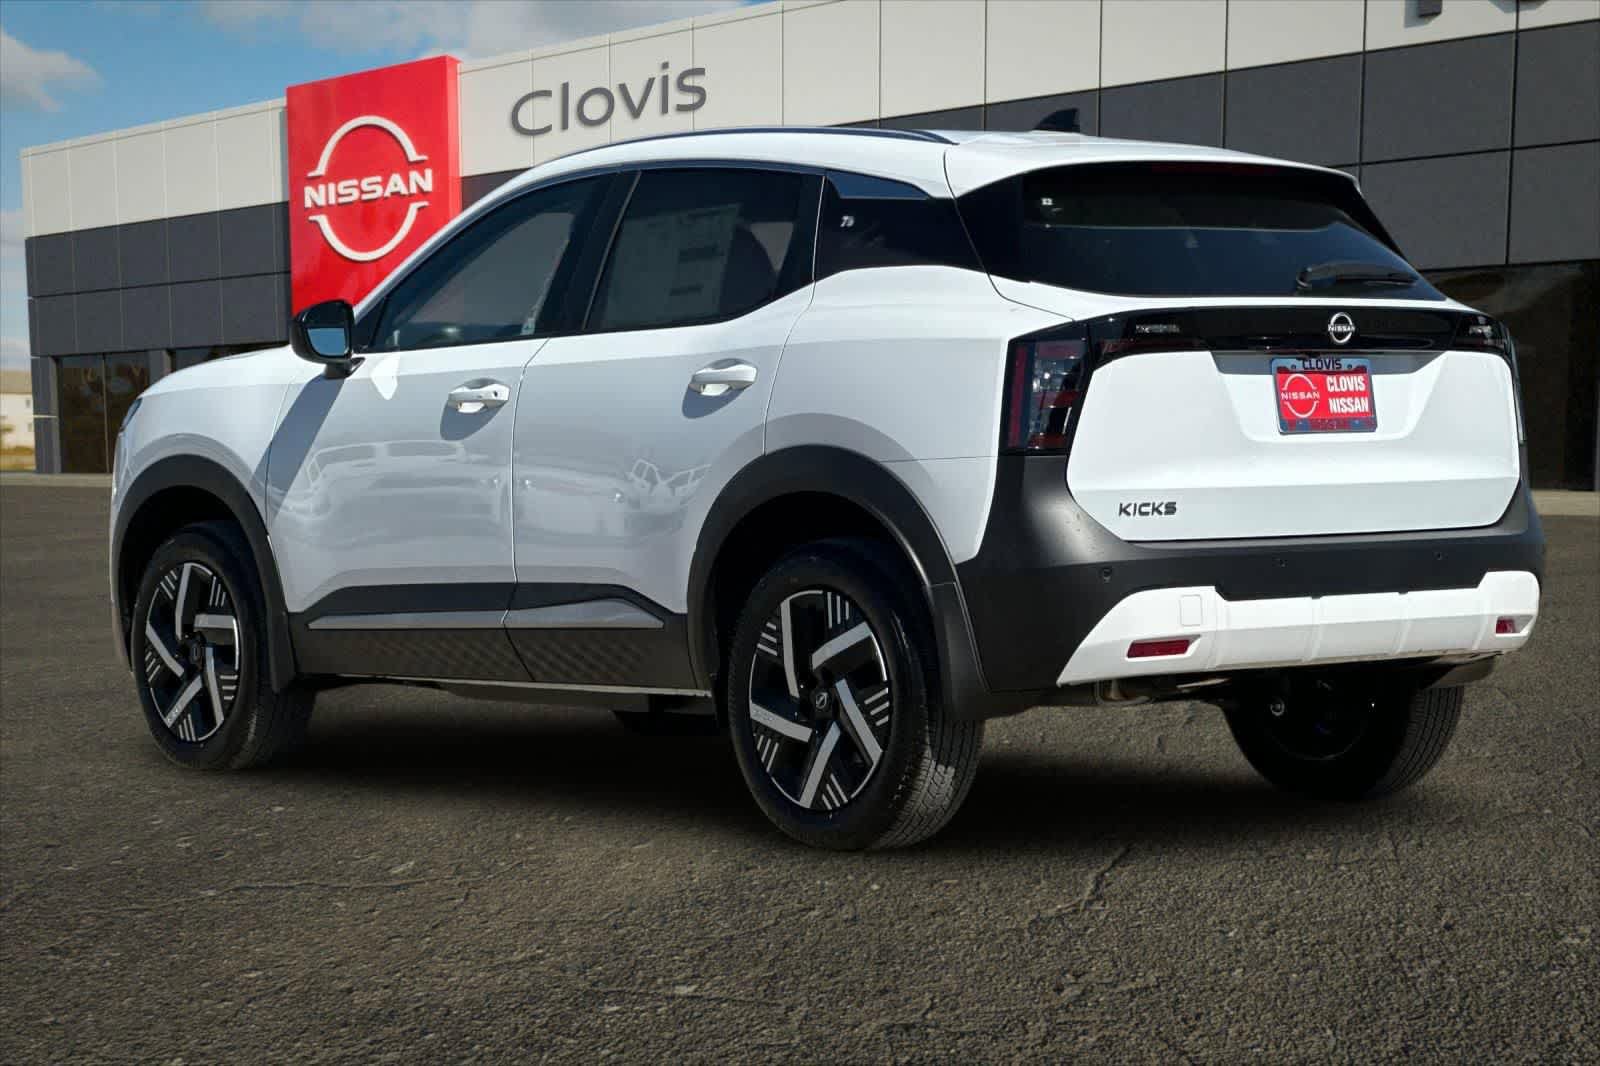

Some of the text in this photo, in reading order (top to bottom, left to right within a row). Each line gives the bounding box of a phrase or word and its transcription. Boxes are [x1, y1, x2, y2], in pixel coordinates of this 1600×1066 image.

[511, 62, 706, 136] Clovis
[304, 167, 433, 209] NISSAN
[1327, 323, 1355, 332] NISSAN
[1303, 359, 1342, 370] CLOVIS
[1326, 375, 1366, 393] CLOVIS
[1281, 391, 1320, 400] NISSAN
[1328, 397, 1369, 414] NISSAN
[1119, 502, 1176, 517] KICKS
